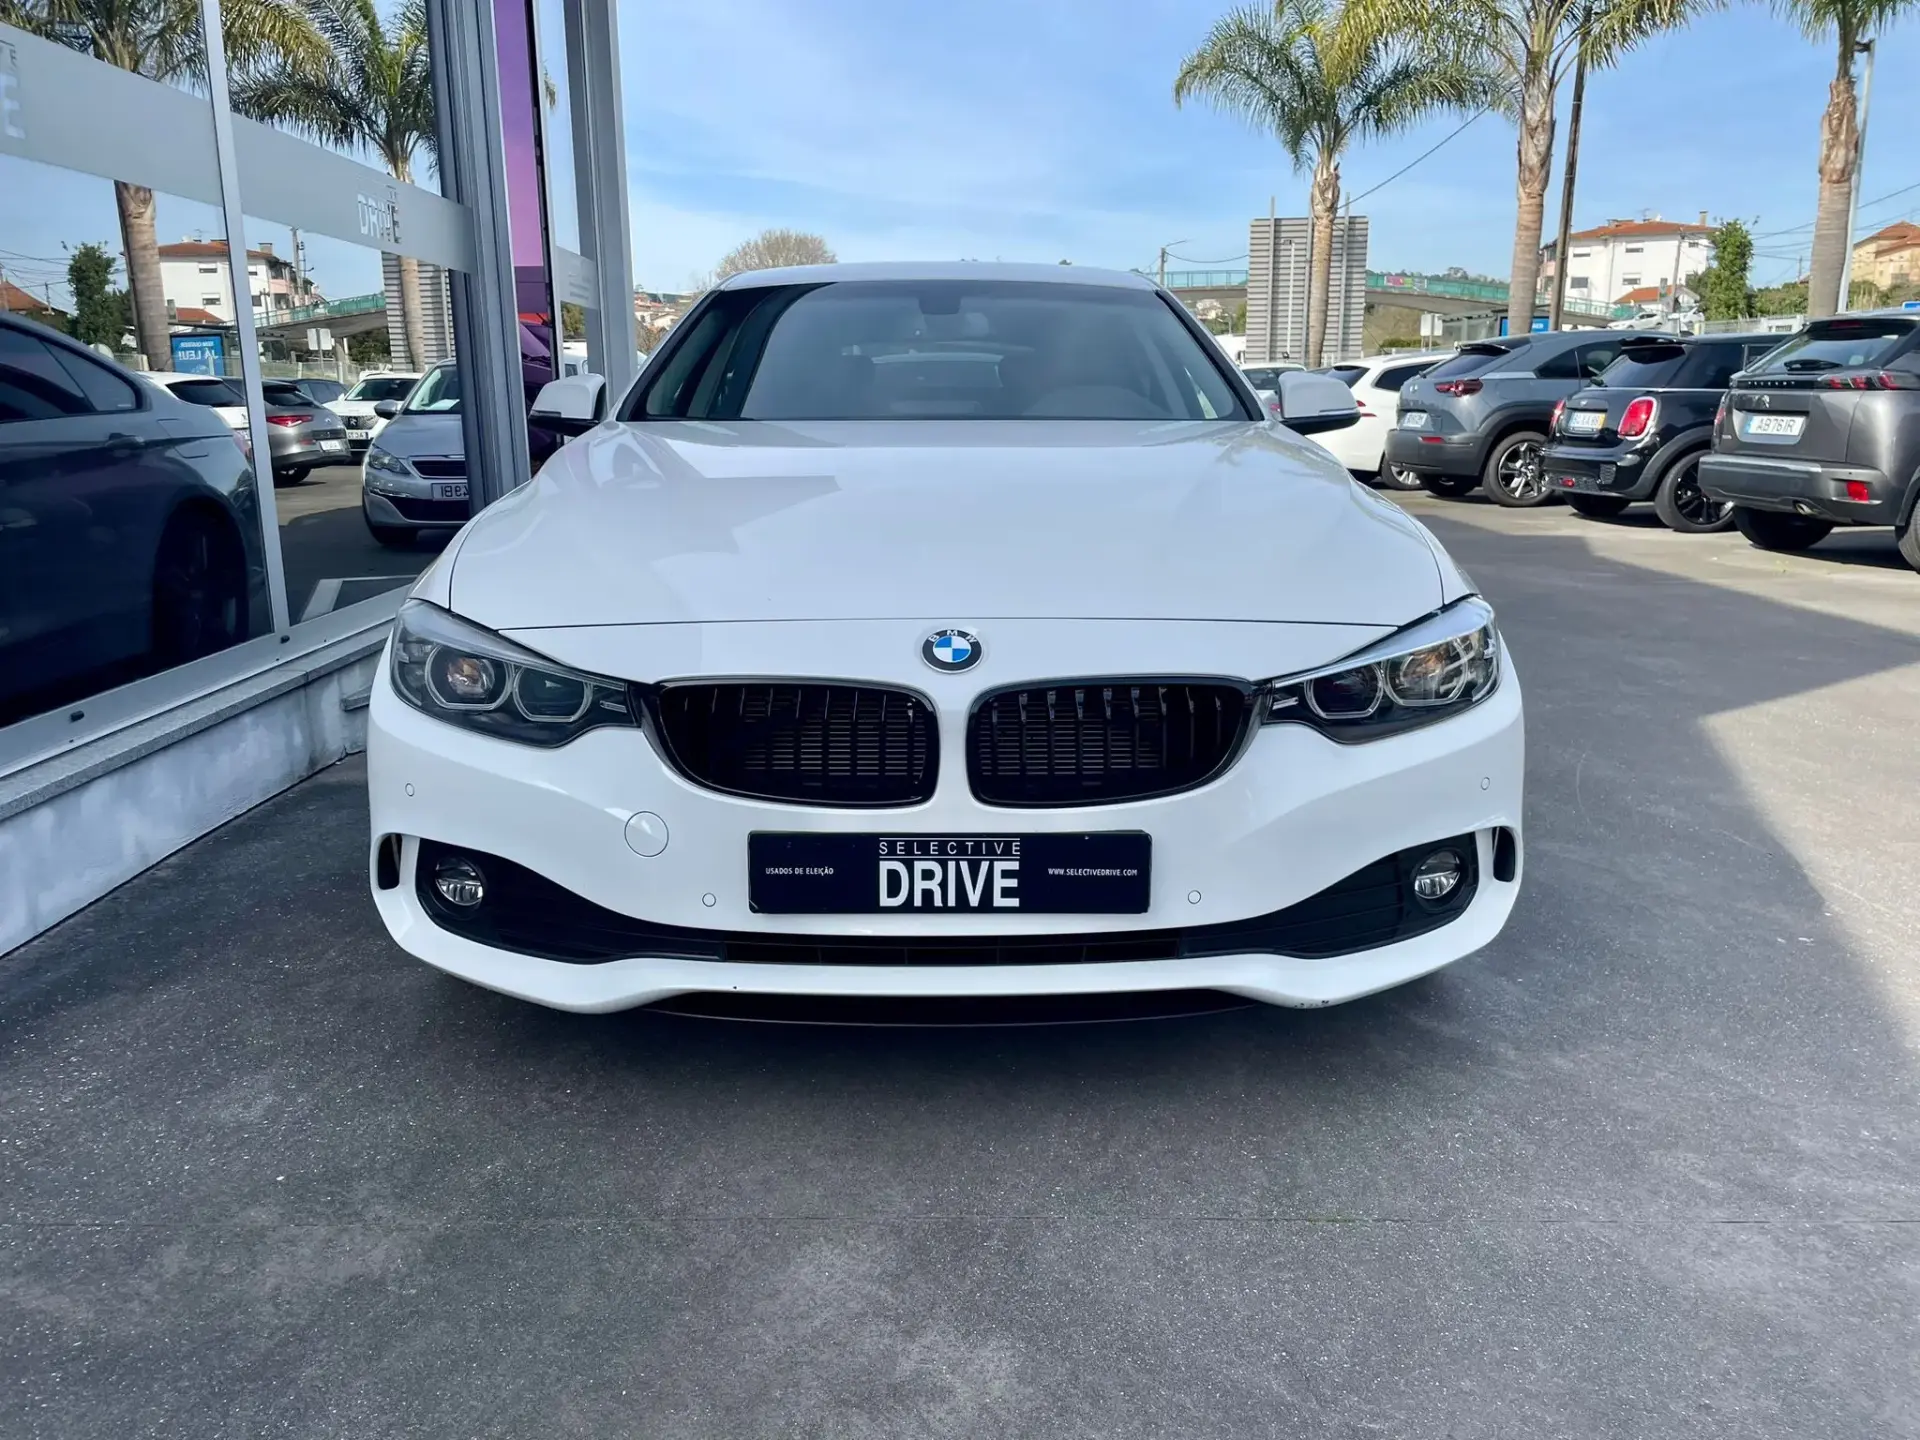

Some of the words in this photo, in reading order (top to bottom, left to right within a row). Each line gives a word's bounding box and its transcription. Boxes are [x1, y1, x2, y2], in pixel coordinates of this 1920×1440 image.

[357, 193, 402, 244] DRIVE
[928, 629, 978, 644] BMW
[879, 841, 1021, 855] SELECTIVE
[765, 867, 793, 875] USADOS
[794, 867, 804, 875] DE
[805, 866, 834, 877] ELEIÇÃO
[1047, 867, 1138, 877] WWW.SELECTIVEDRIVE.COM
[879, 860, 1020, 908] DRIVE
